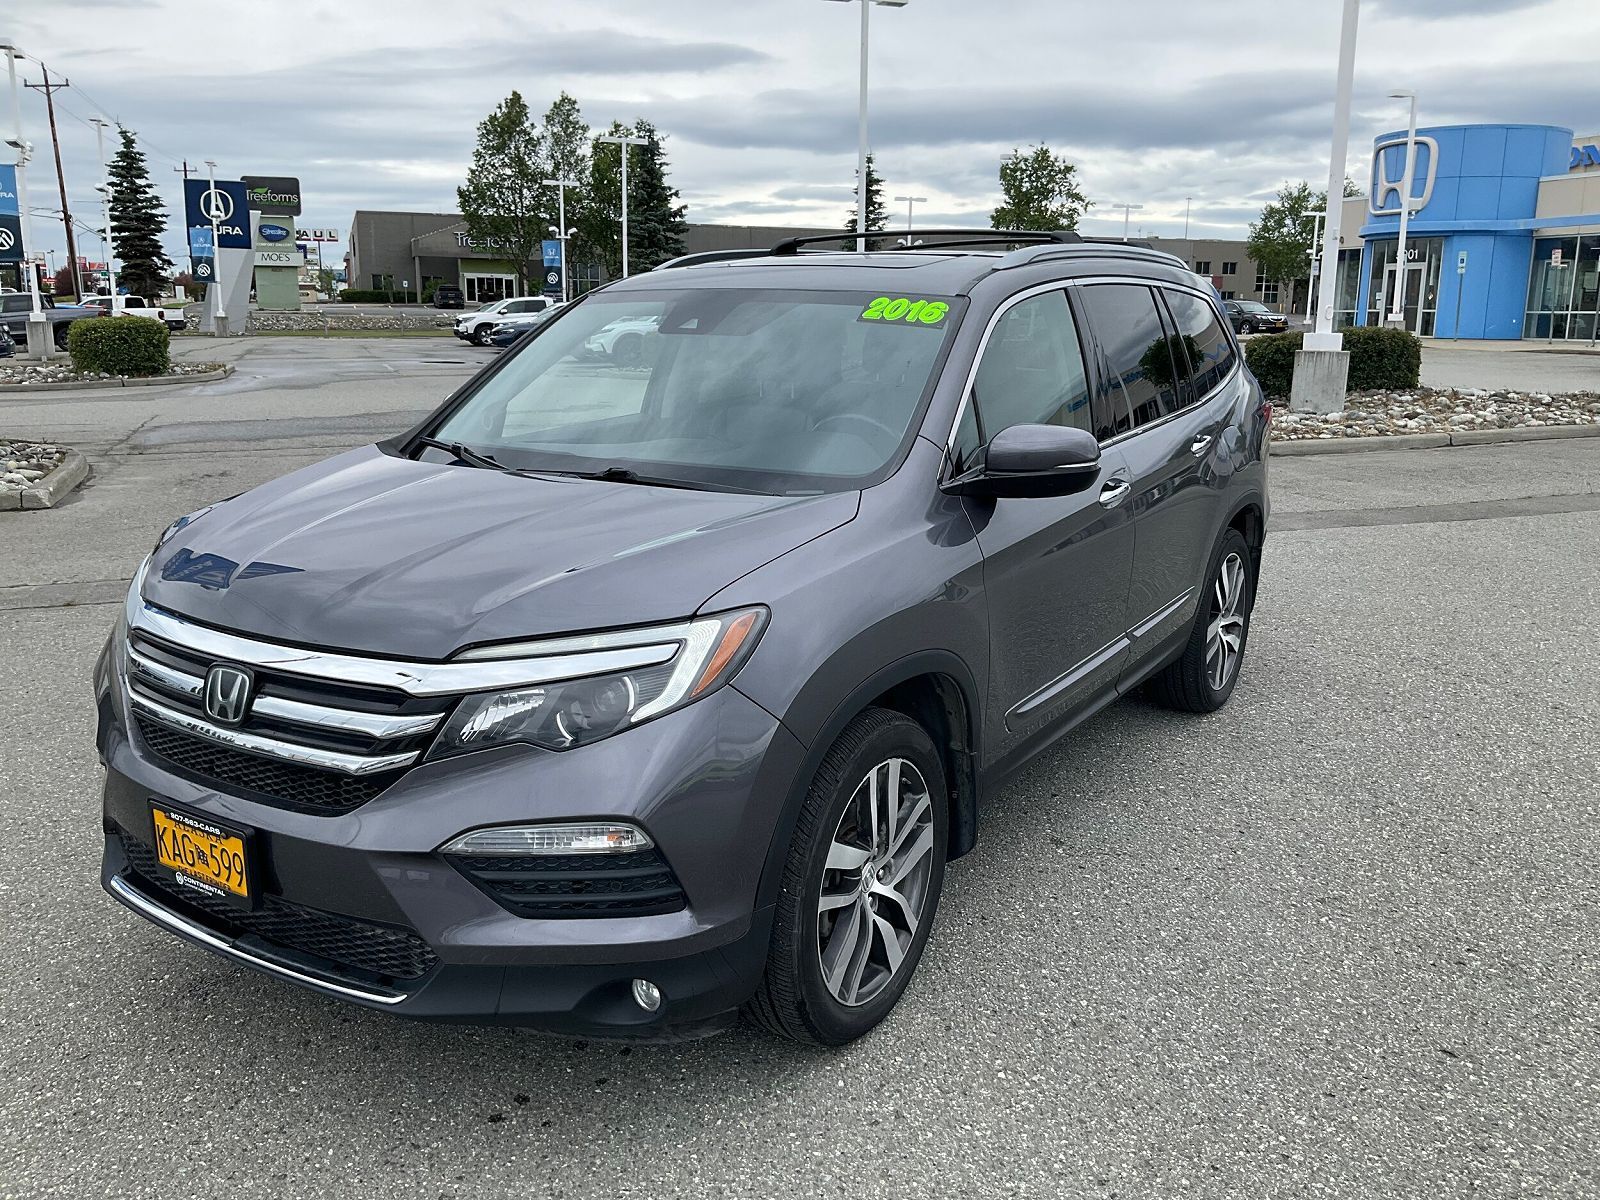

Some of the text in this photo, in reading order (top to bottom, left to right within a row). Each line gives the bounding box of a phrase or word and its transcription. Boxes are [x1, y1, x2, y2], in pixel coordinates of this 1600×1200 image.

[246, 189, 299, 203] Treeforms
[196, 225, 243, 236] URA
[261, 253, 291, 262] MOE'S
[862, 297, 949, 324] 2016
[156, 824, 244, 887] KAG 599
[183, 875, 226, 897] CONTINENTAL
